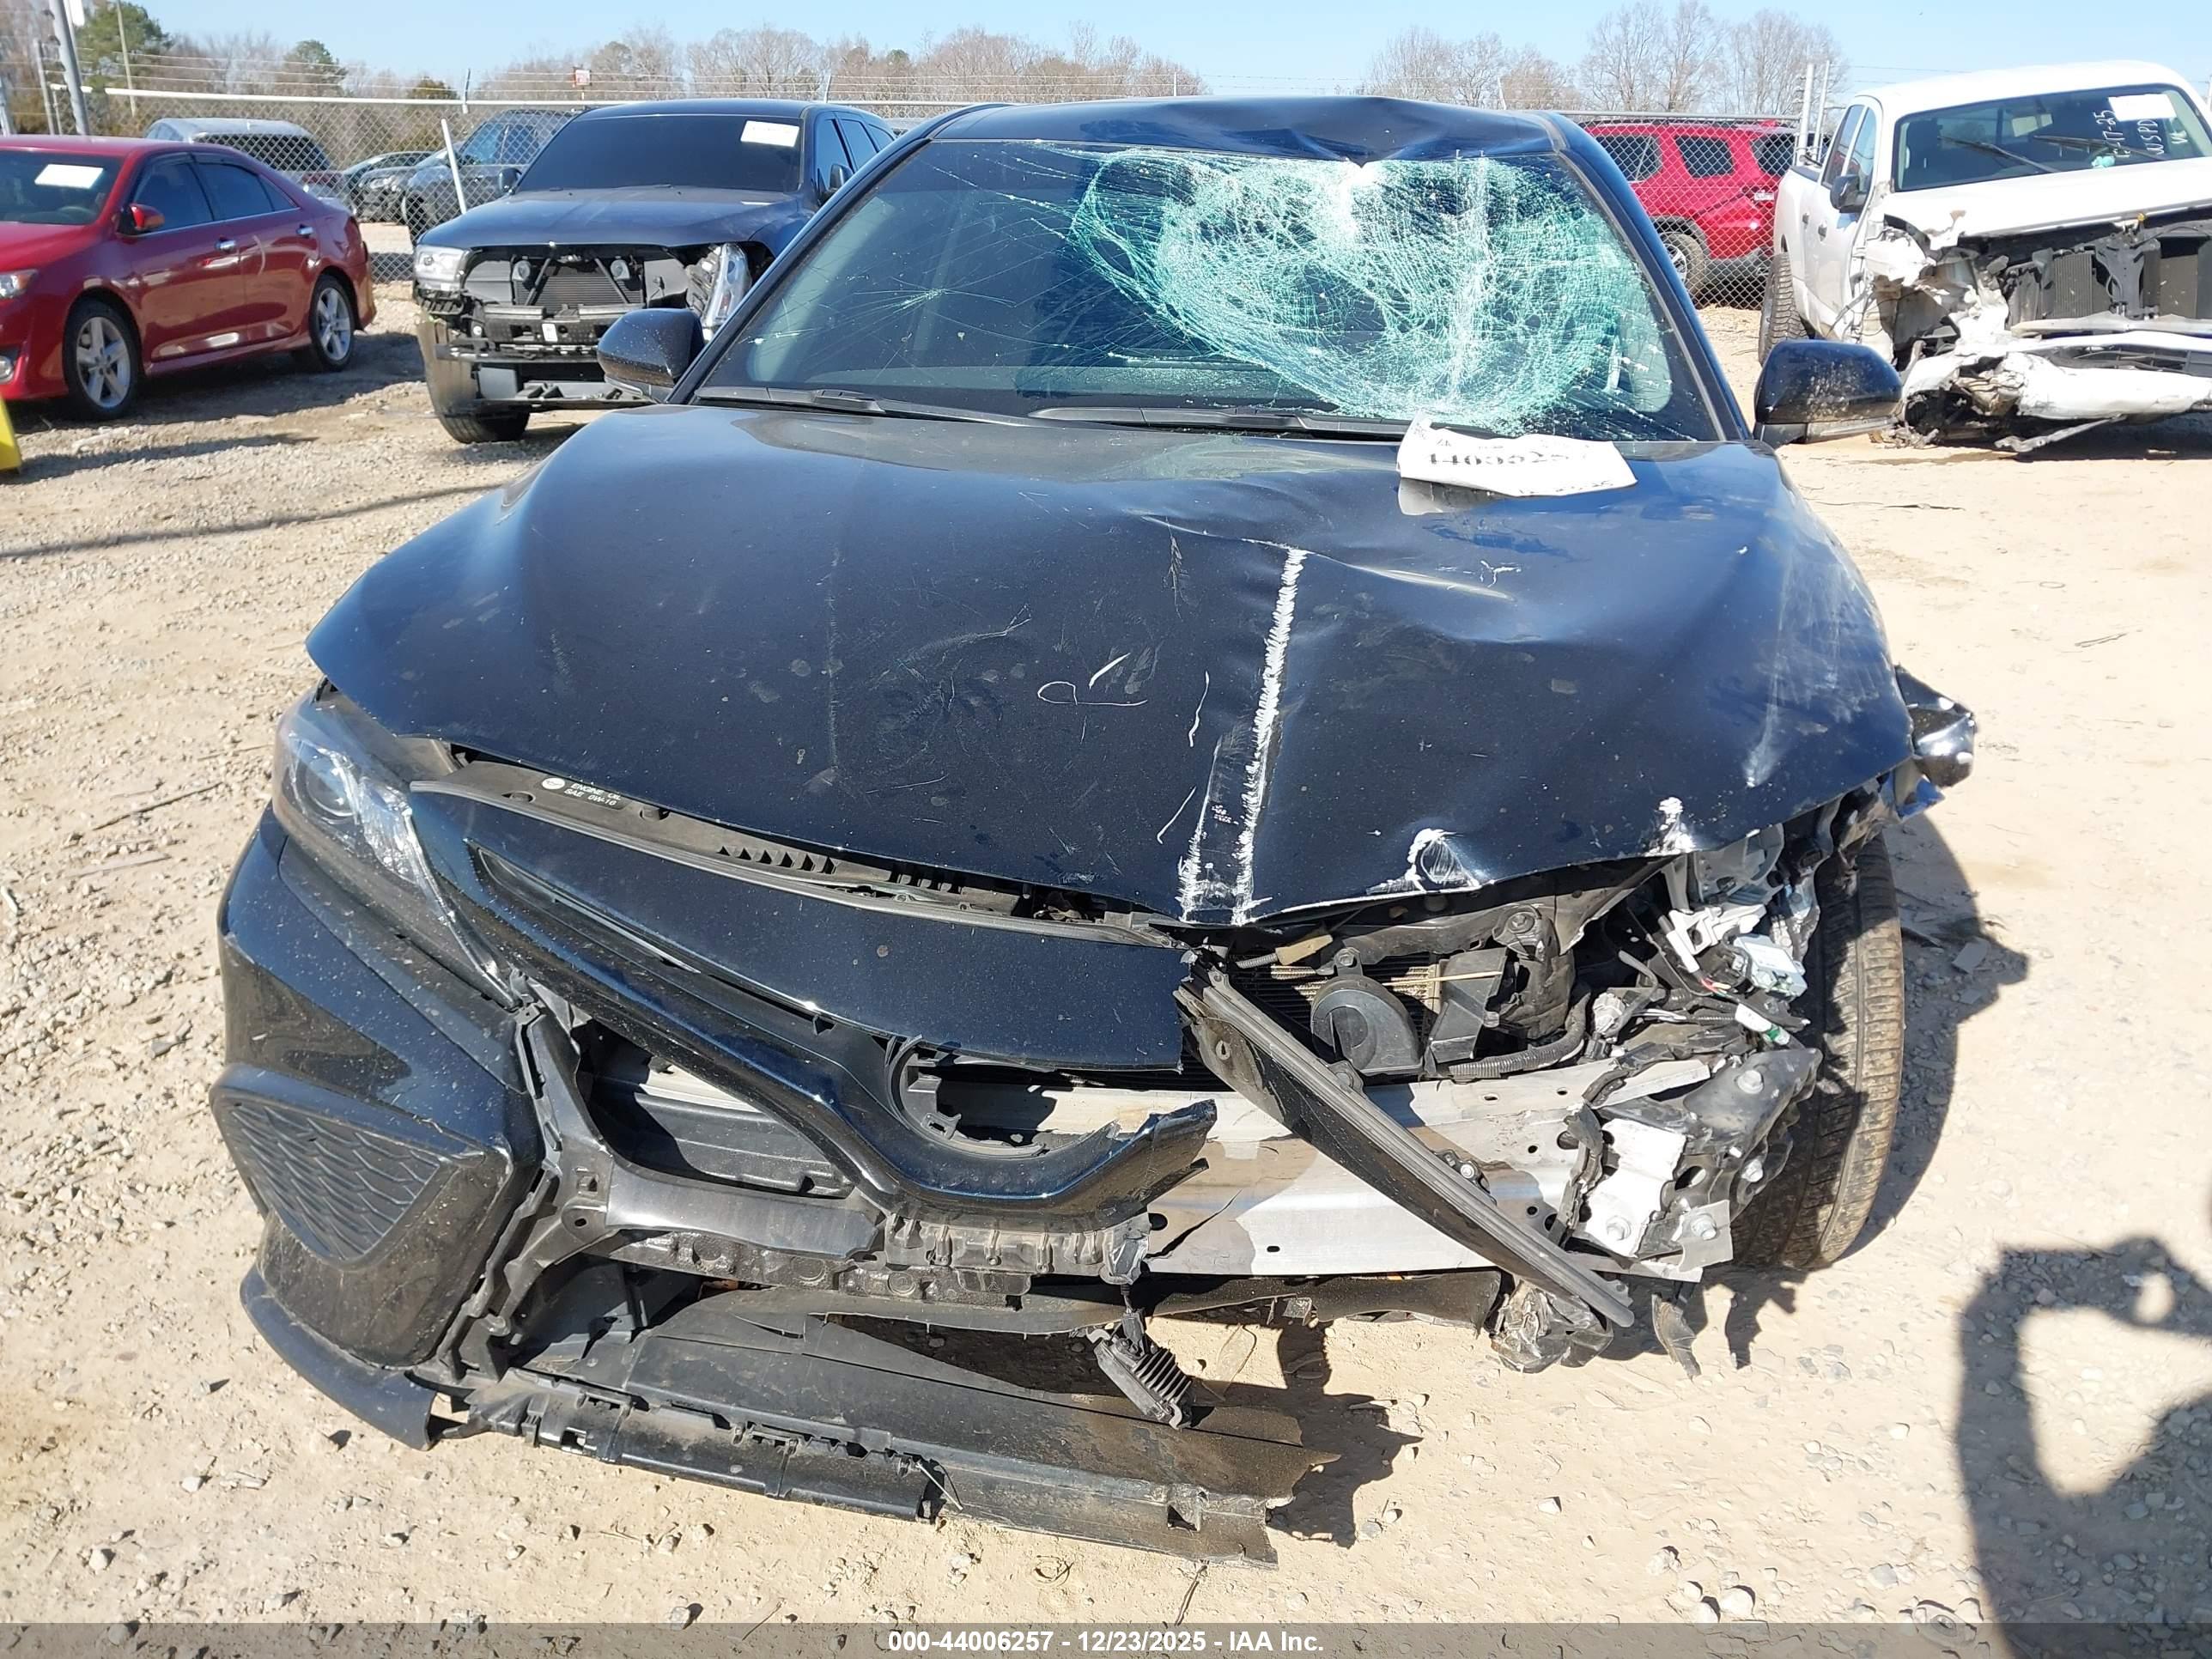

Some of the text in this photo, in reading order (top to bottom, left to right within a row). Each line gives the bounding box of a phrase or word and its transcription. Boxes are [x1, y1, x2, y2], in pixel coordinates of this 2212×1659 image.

[571, 782, 605, 795] ENGINE
[564, 788, 617, 805] SAE 0W-16
